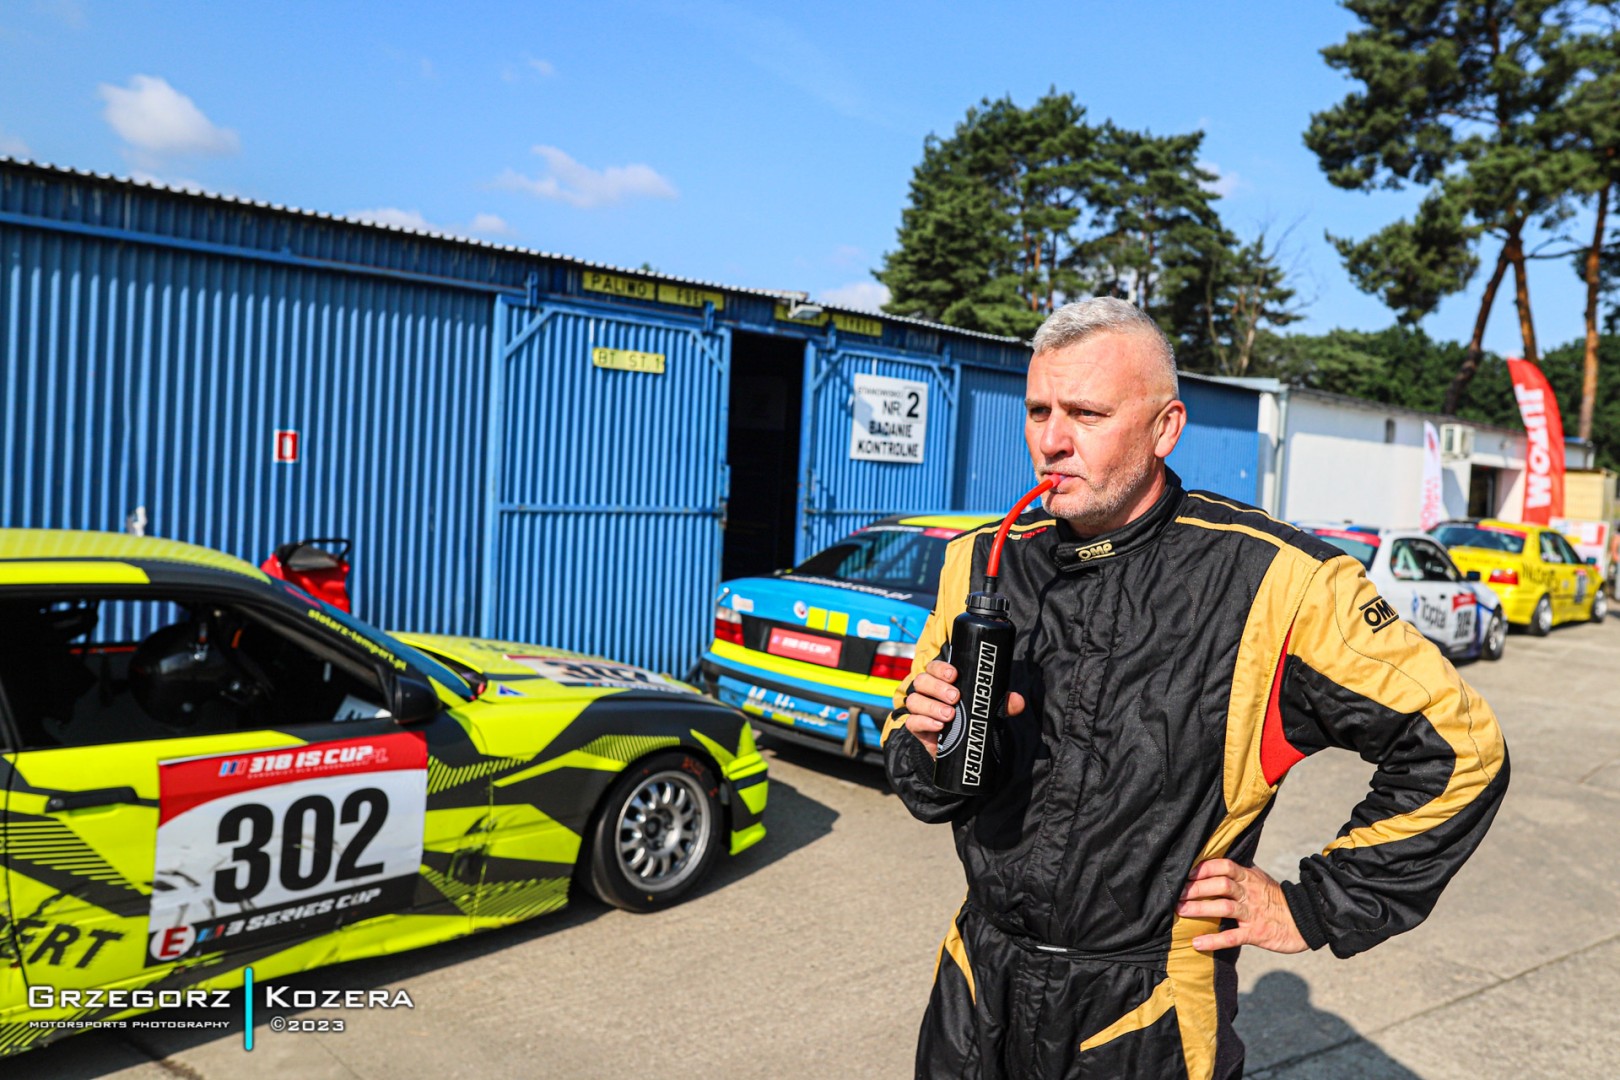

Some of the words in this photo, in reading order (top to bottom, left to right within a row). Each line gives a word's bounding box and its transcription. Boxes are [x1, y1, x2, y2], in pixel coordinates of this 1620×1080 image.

[591, 273, 647, 297] PALIWO
[598, 351, 616, 365] BT
[905, 391, 920, 418] 2
[868, 419, 913, 439] BADANIE
[857, 439, 919, 458] KONTROLNE
[1077, 542, 1114, 560] OMP
[1363, 599, 1397, 627] OM
[971, 641, 998, 719] MARCIN
[249, 753, 293, 774] 318
[294, 749, 323, 769] IS
[323, 744, 373, 765] CUP
[962, 719, 988, 786] WYDRA
[213, 787, 390, 904] 302
[225, 919, 245, 936] 3
[245, 898, 336, 932] SERIES
[335, 888, 382, 910] CUP
[159, 926, 188, 958] E
